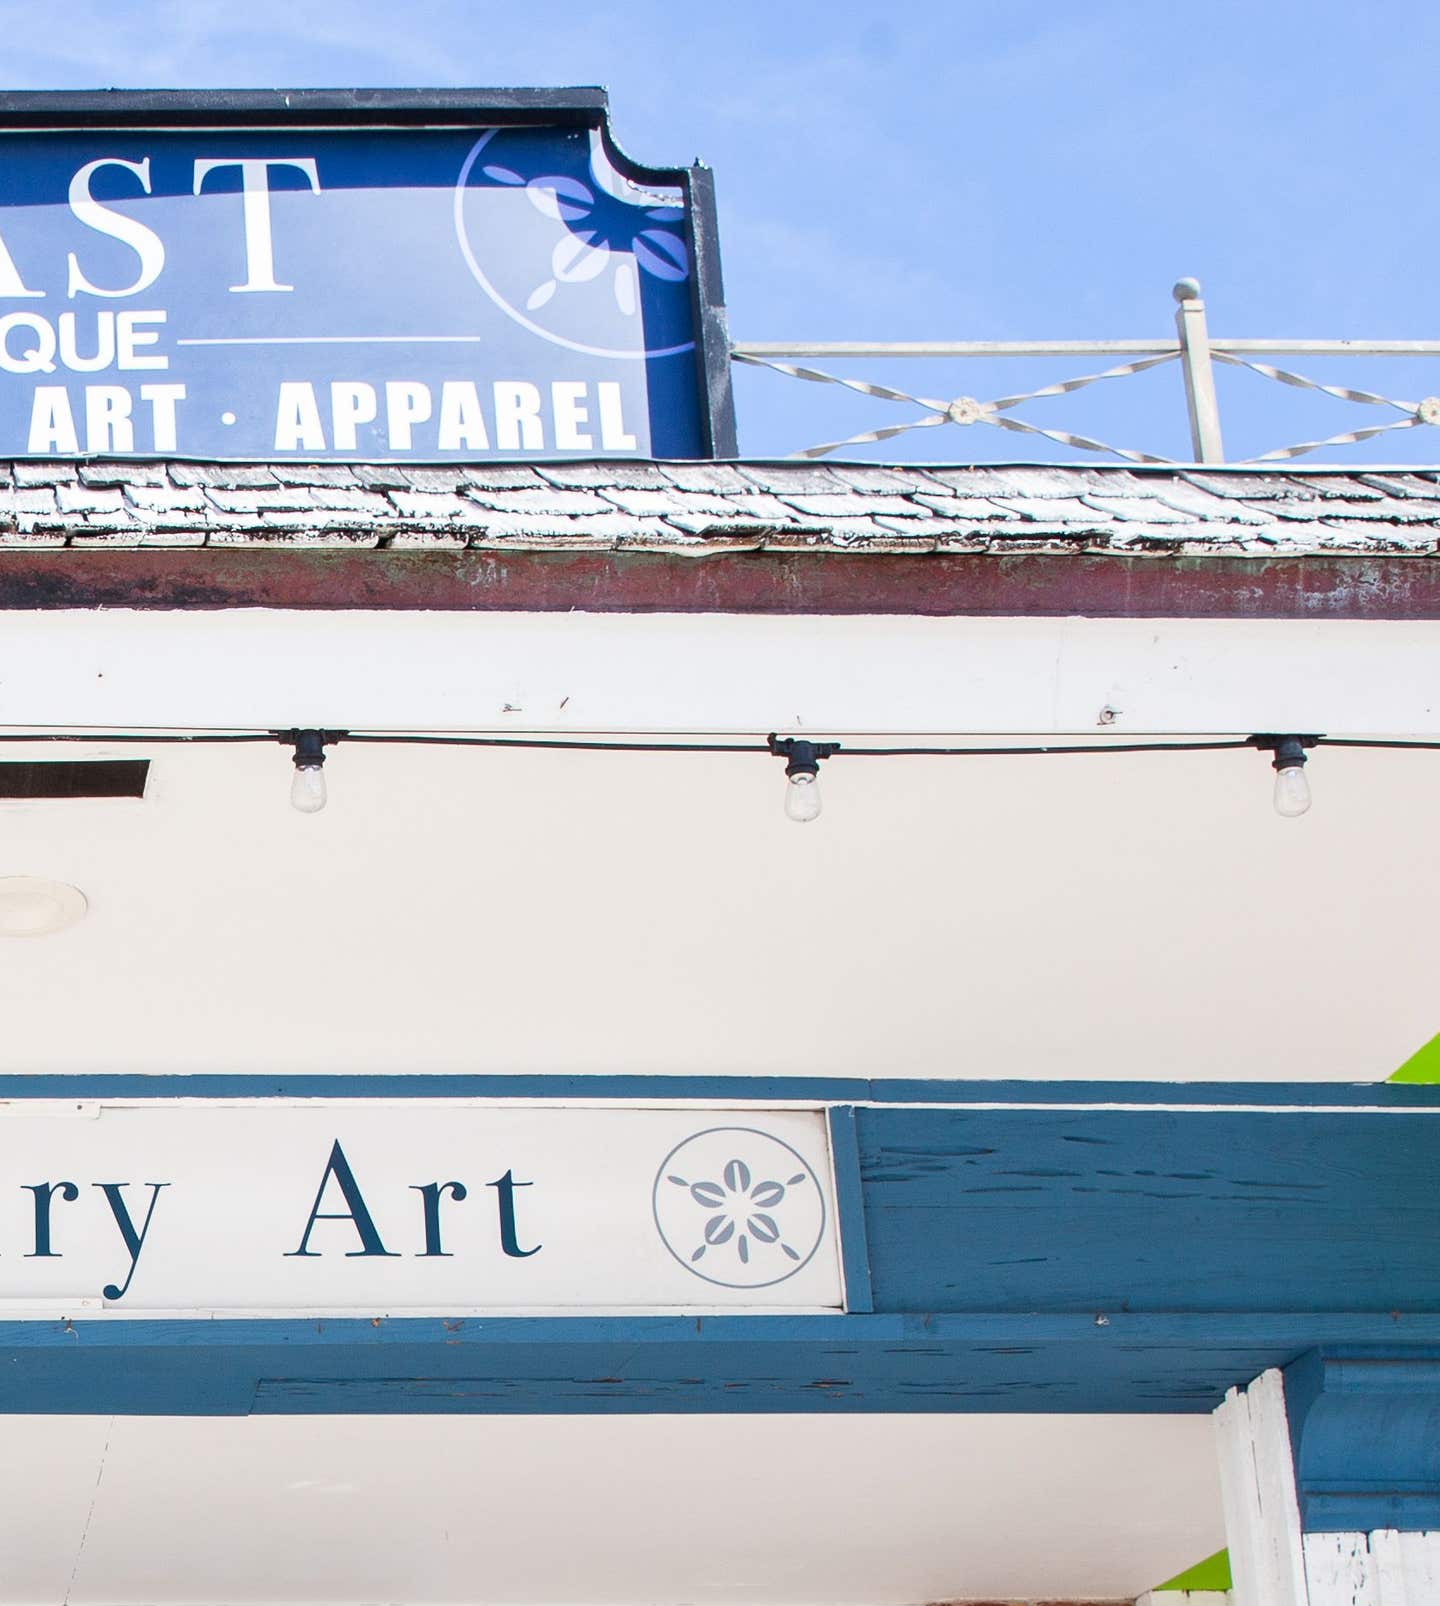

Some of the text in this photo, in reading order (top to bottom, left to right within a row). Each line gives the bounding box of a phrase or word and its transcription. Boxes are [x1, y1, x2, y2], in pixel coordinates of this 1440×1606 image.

[27, 384, 187, 453] ART
[274, 381, 637, 451] APPAREL
[283, 1138, 542, 1259] Art
